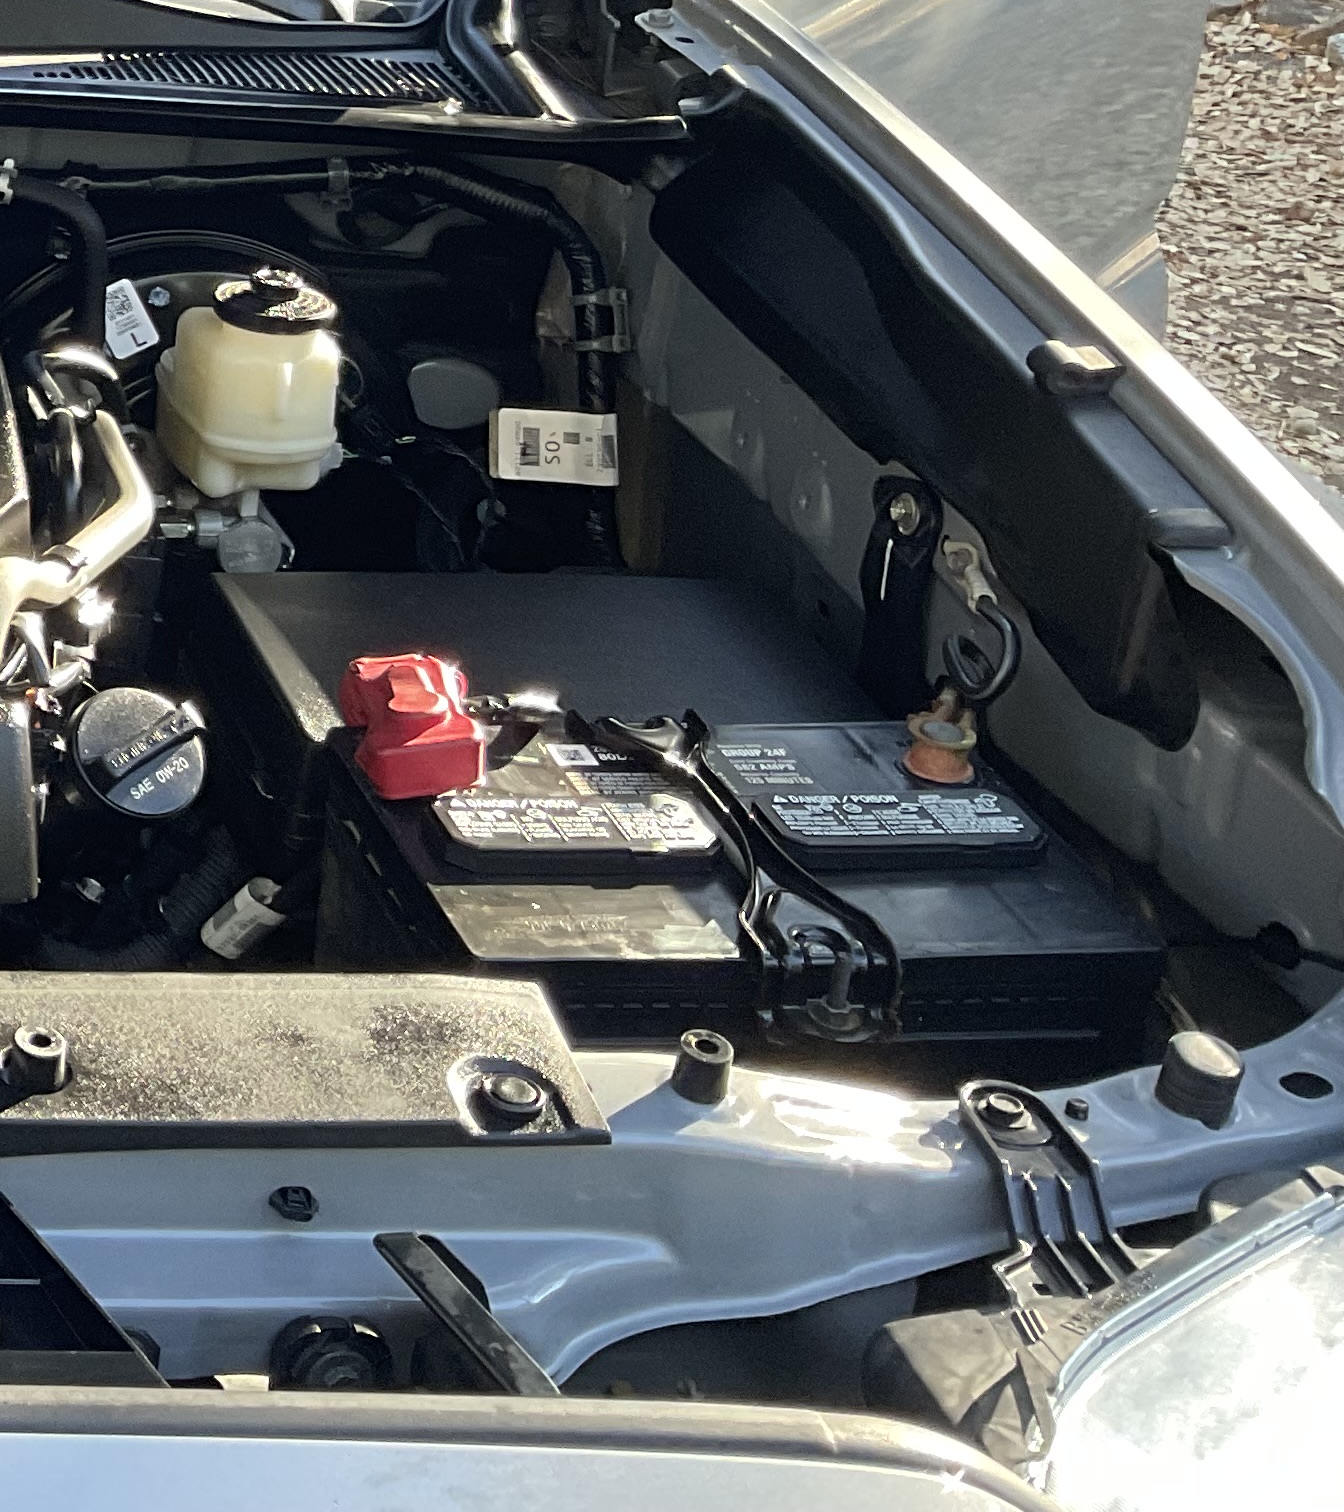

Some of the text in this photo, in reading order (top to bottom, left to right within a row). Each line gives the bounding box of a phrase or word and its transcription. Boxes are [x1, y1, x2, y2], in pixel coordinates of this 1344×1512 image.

[129, 332, 148, 348] L
[720, 748, 762, 757] GROUP
[129, 756, 190, 801] SAE 0W-20
[850, 794, 899, 804] POISON
